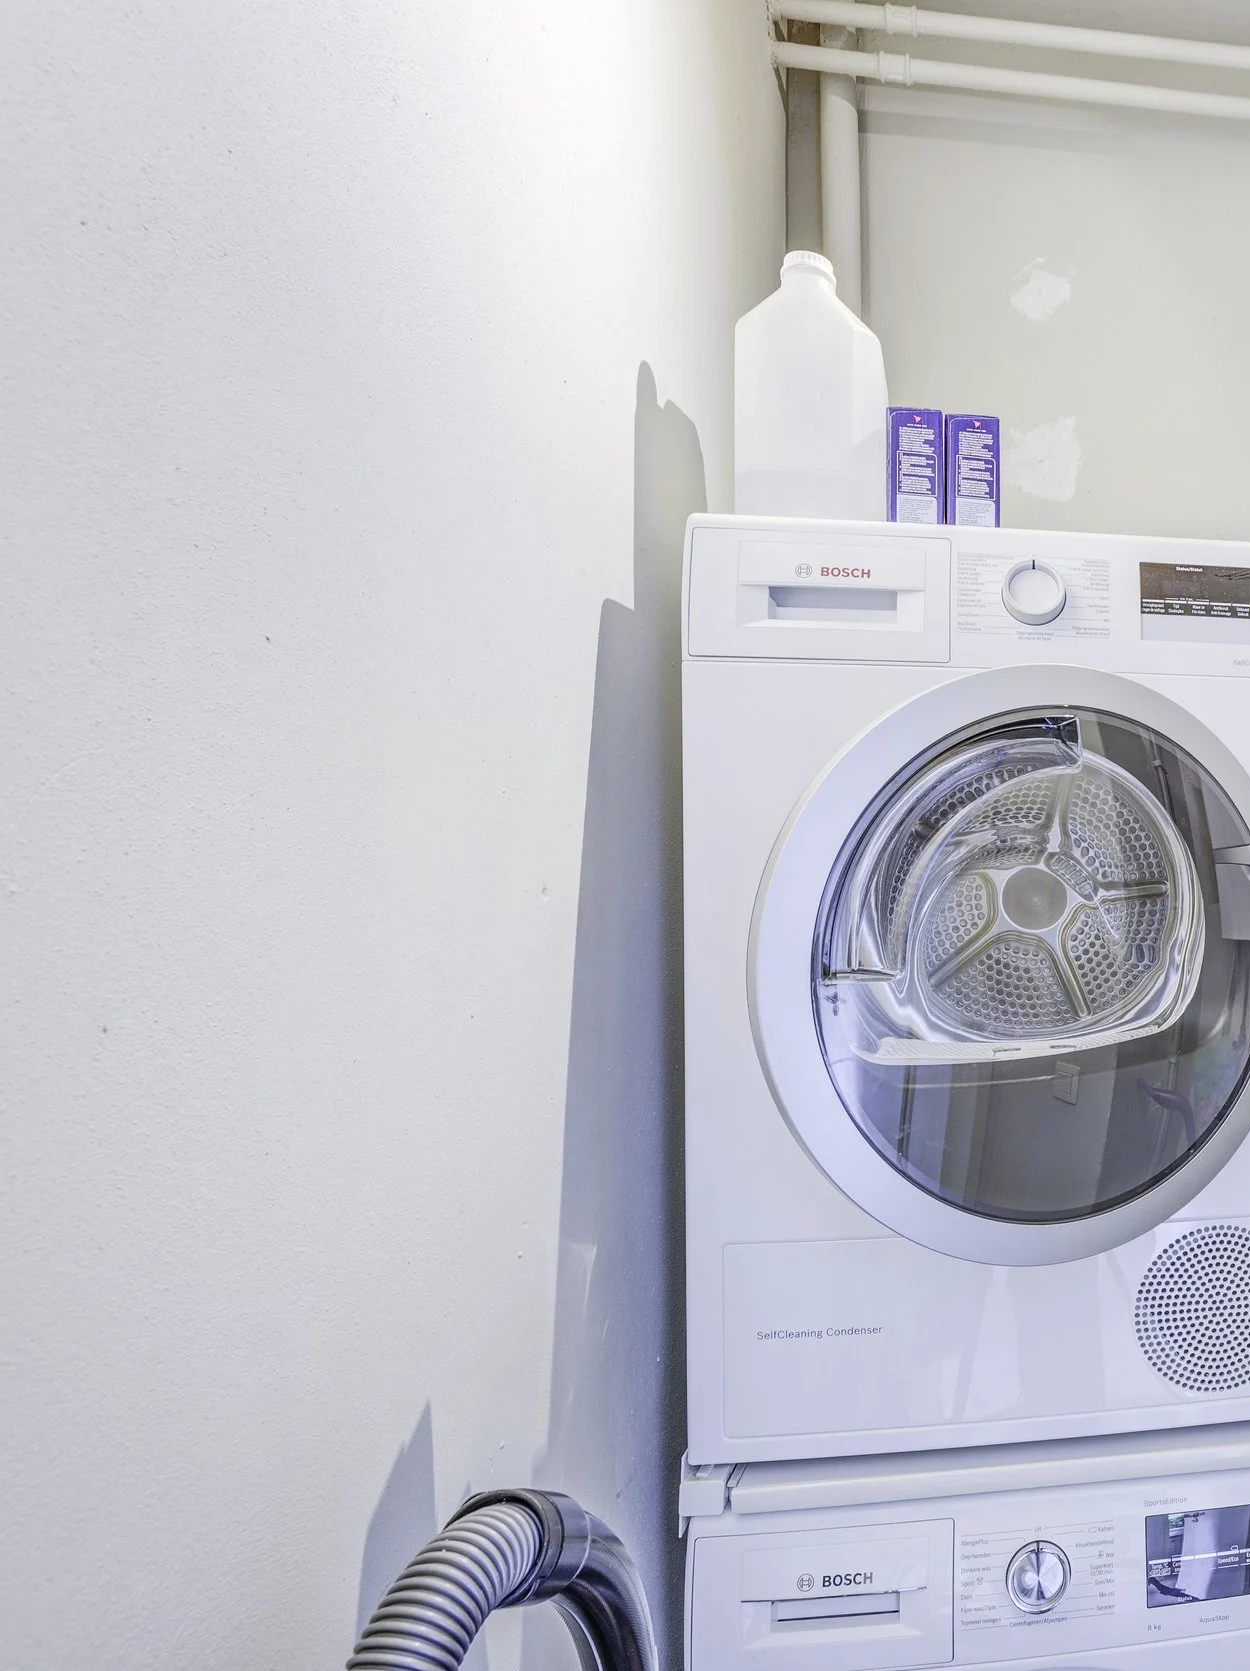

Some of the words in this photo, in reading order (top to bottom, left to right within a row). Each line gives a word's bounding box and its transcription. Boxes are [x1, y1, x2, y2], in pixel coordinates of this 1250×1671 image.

[820, 566, 871, 578] BOSCH
[756, 1329, 823, 1341] SelfCleaning
[826, 1326, 883, 1337] Condenser
[1144, 1496, 1188, 1507] SportsEdition
[961, 1538, 989, 1546] AllergiePlus
[961, 1552, 992, 1560] Overhemden
[961, 1566, 980, 1574] Donkere
[822, 1571, 874, 1588] BOSCH
[961, 1580, 975, 1588] Sport
[1199, 1613, 1230, 1624] AquaStop
